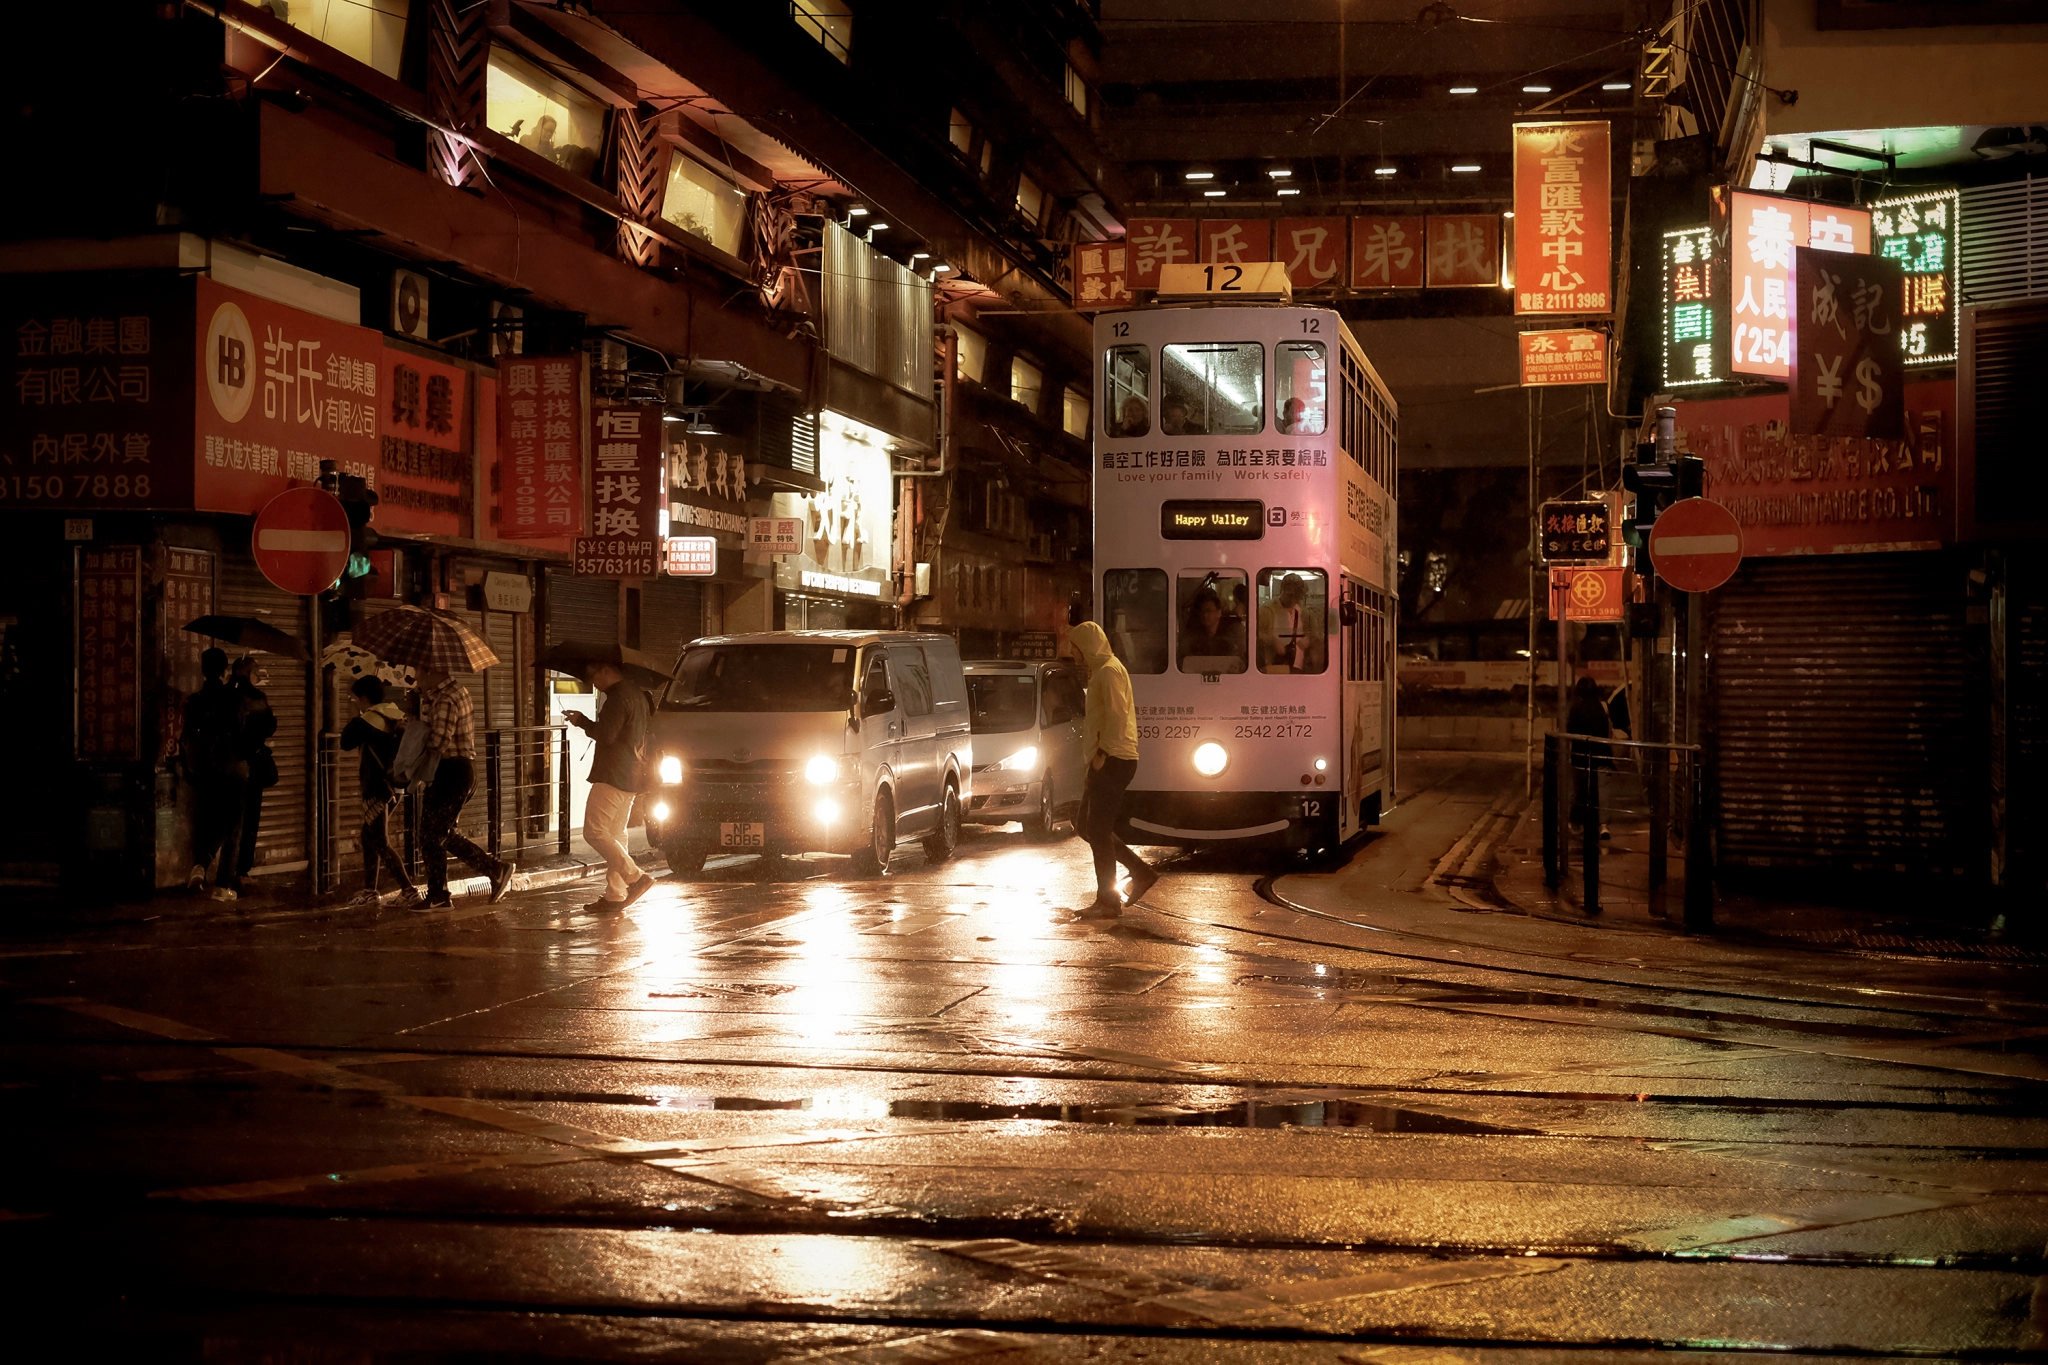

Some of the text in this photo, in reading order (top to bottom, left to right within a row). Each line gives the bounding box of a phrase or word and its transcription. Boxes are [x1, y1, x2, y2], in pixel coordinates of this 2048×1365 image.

[1541, 130, 1585, 291] 永富匯款中心
[1203, 265, 1243, 292] 12
[1546, 294, 1574, 310] 2111
[1577, 292, 1606, 308] 3986
[1735, 275, 1788, 319] 人民
[1112, 321, 1130, 337] 12
[1300, 318, 1320, 334] 12
[16, 315, 150, 357] 金融集團
[1529, 334, 1597, 353] 永富
[263, 324, 323, 429] 許氏
[326, 352, 376, 398] 金融集團
[1550, 373, 1574, 381] 2111
[1576, 371, 1602, 380] 3986
[15, 365, 150, 405] 有限公司
[325, 397, 376, 440] 有限公司
[1102, 449, 1327, 469] 高空工作好危險 為咗全家要檢點
[595, 410, 642, 537] 恒豐找換
[1118, 468, 1312, 484] Love your family Work safely
[73, 474, 152, 500] 7888
[1175, 514, 1249, 526] Happy Valley
[578, 558, 653, 575] 35763115
[1165, 726, 1200, 739] 2297
[1234, 725, 1272, 738] 2542
[1276, 724, 1312, 738] 2172
[1302, 801, 1320, 817] 12
[733, 823, 751, 834] NP
